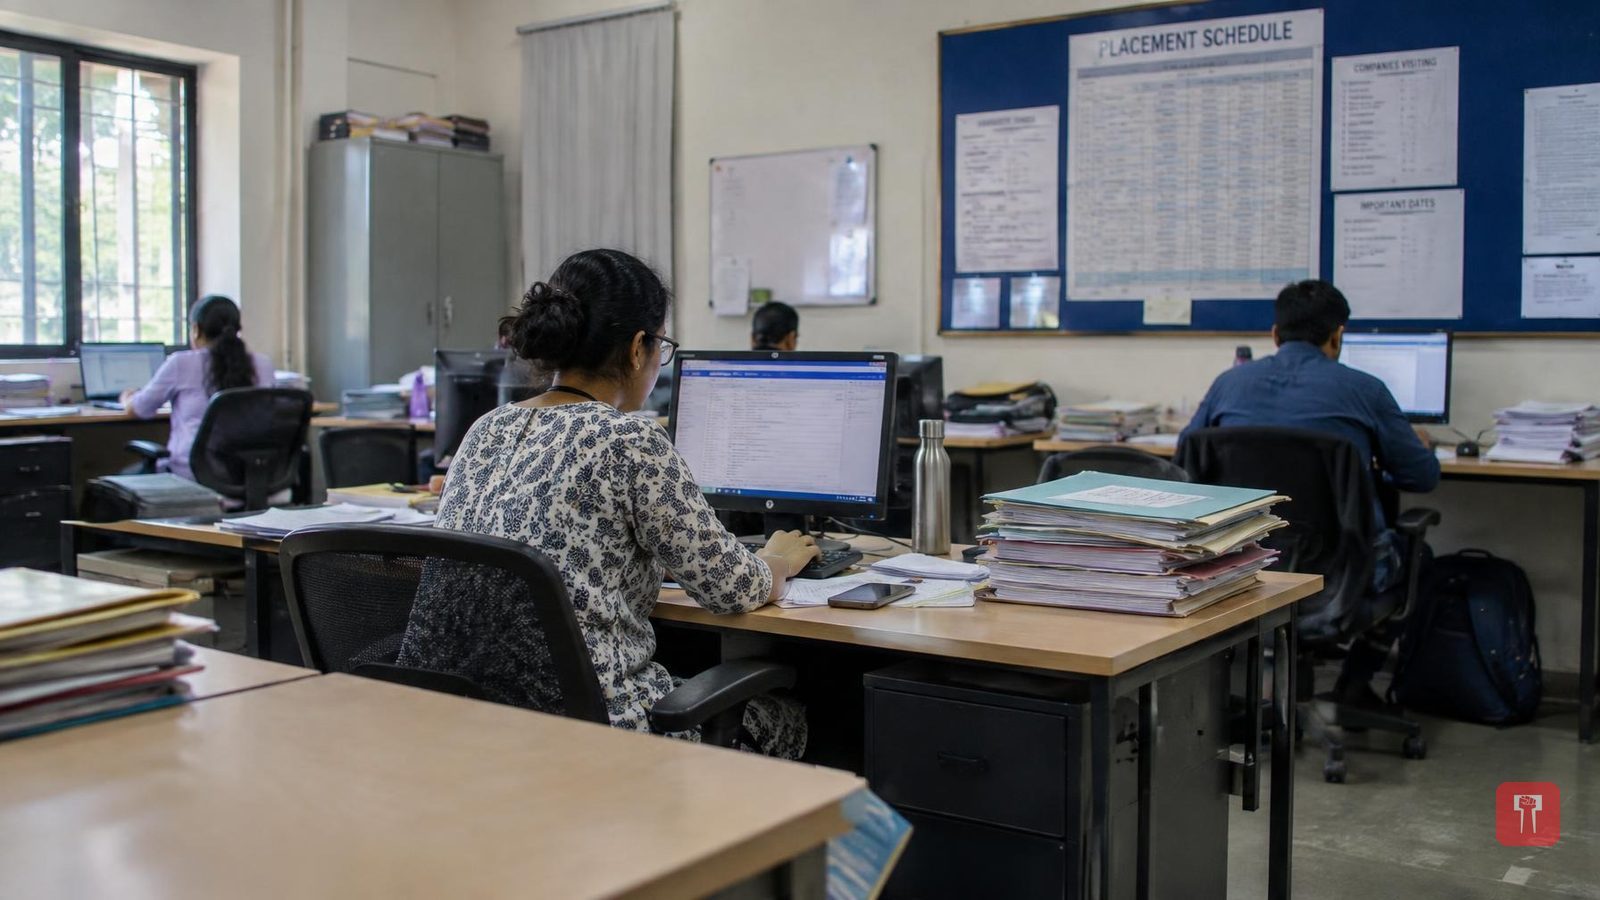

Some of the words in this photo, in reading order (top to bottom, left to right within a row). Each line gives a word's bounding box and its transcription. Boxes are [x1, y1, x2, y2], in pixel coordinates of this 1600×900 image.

[1099, 30, 1197, 58] PLACEMENT
[1203, 21, 1293, 48] SCHEDULE
[1401, 57, 1437, 69] VISITING
[1360, 199, 1406, 210] IMPORTANT
[1408, 198, 1436, 209] DATES
